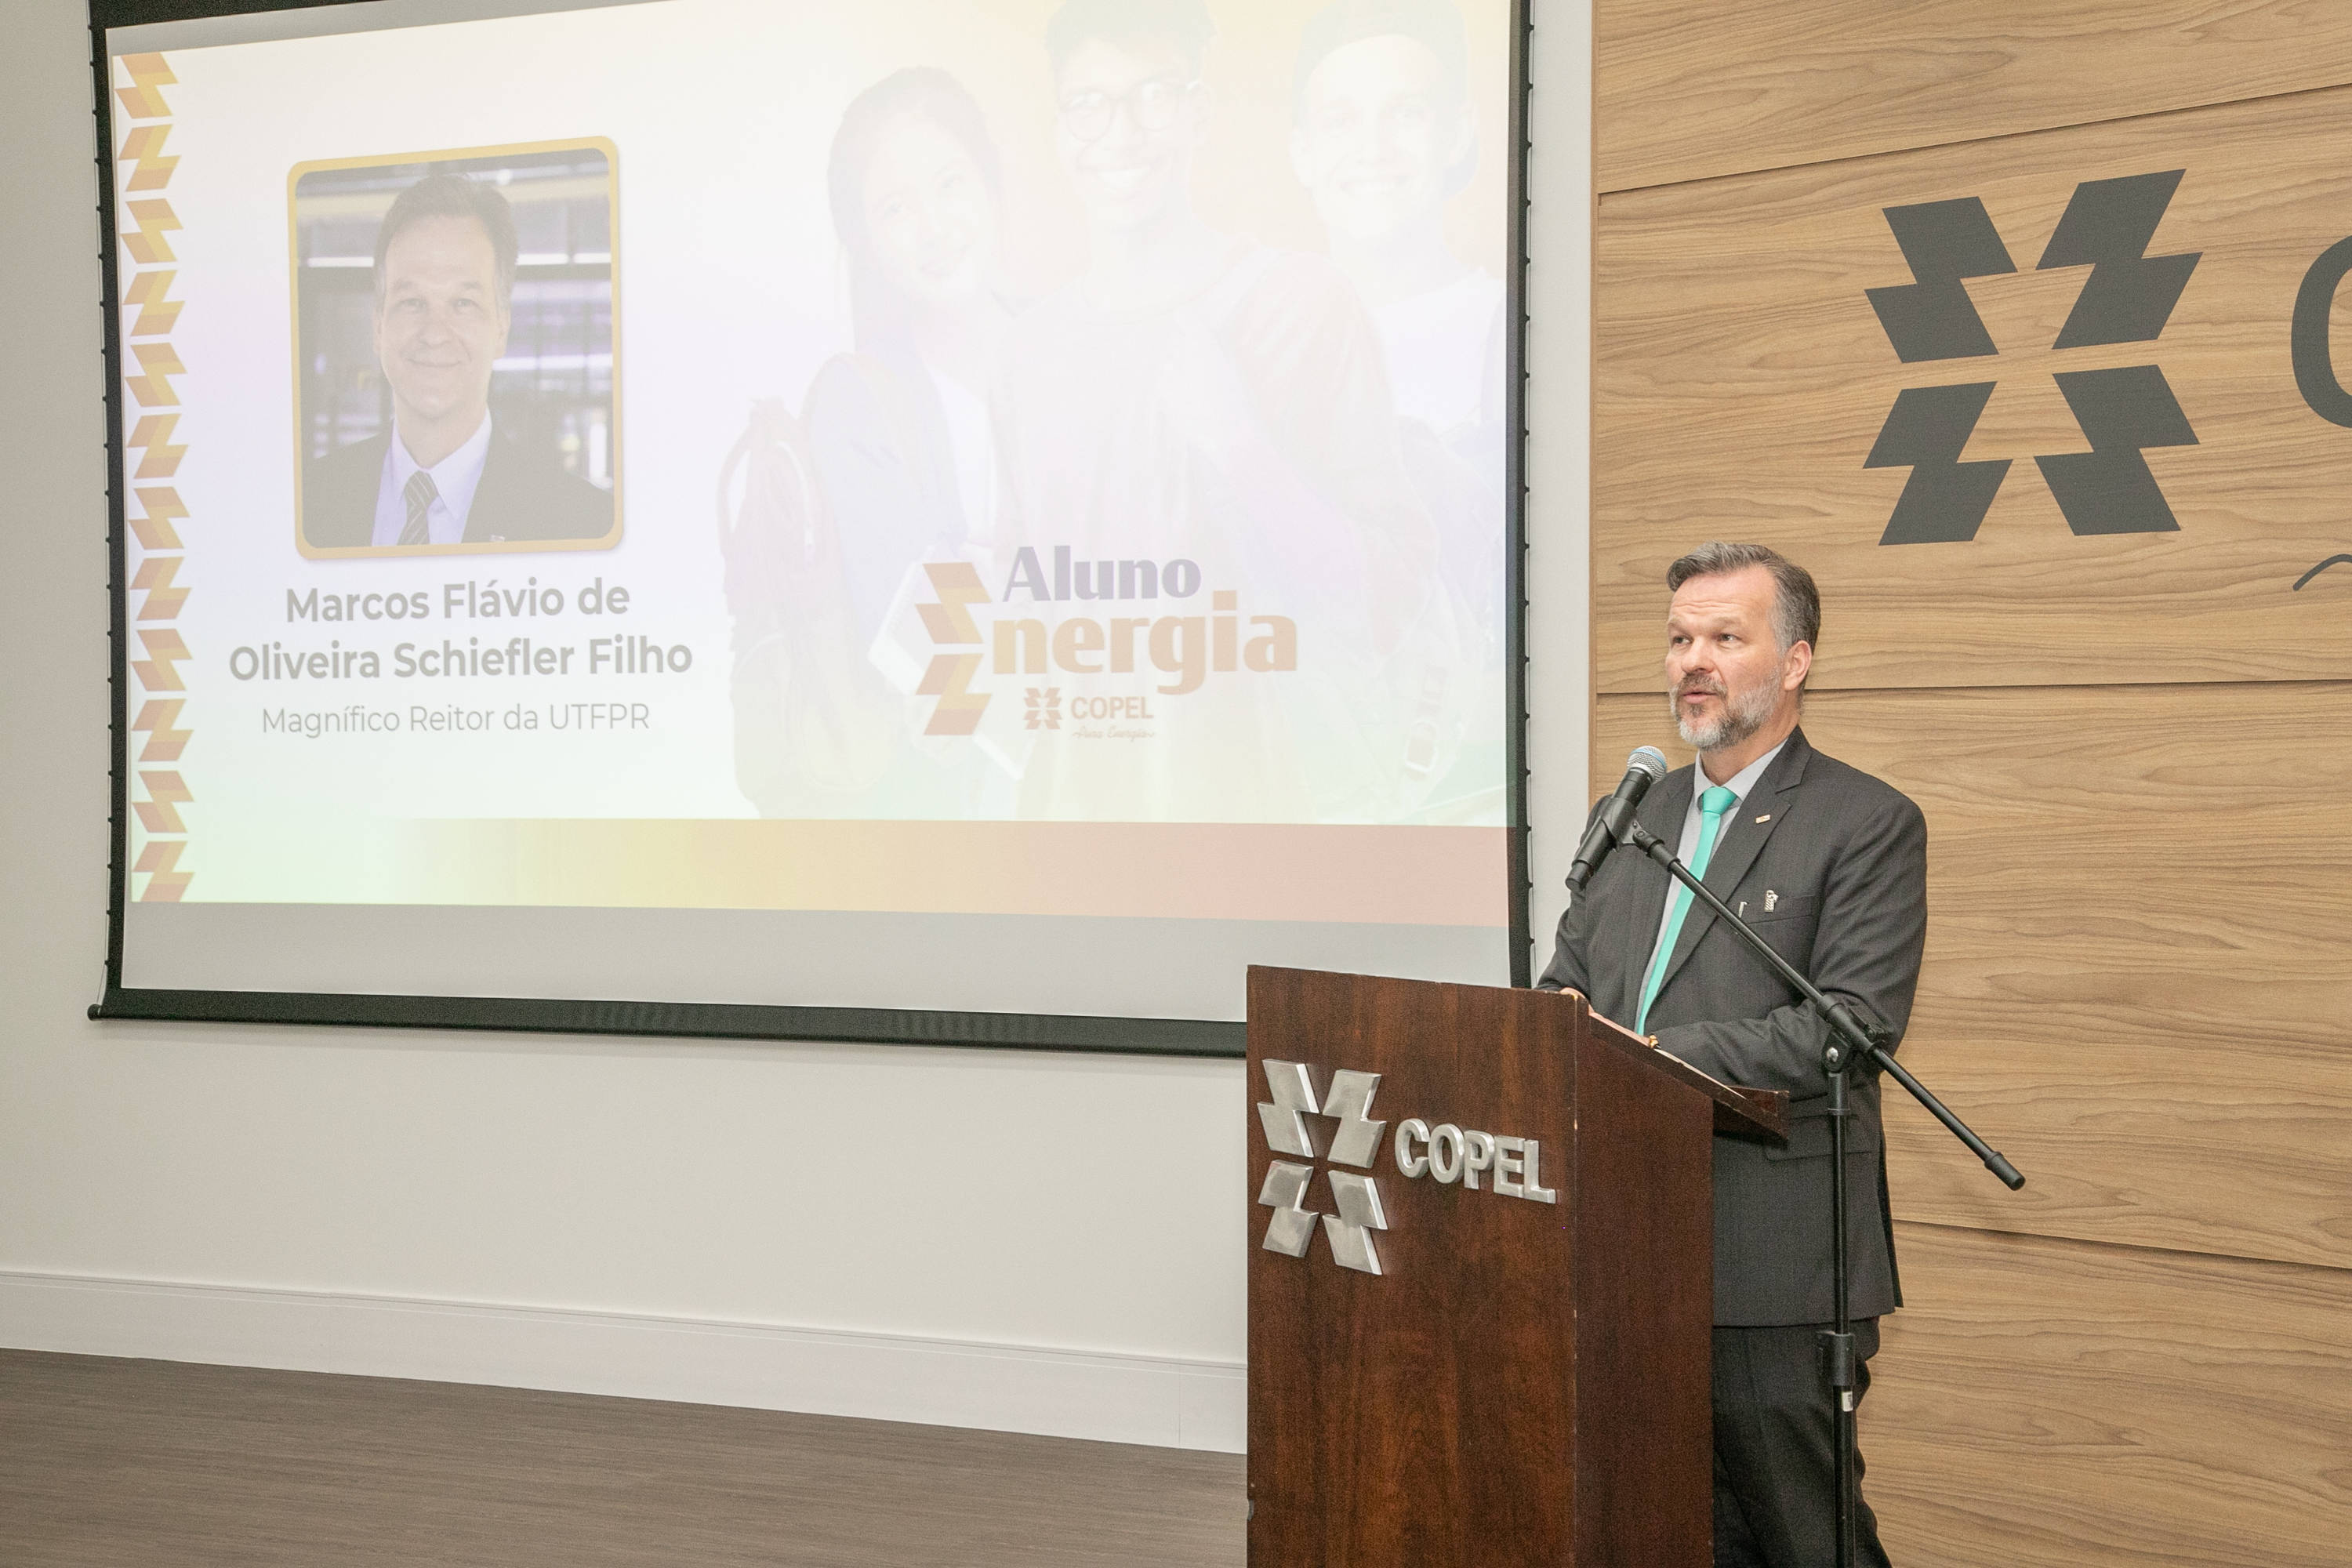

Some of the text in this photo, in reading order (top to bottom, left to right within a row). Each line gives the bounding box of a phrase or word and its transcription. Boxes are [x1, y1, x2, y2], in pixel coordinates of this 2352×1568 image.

[1002, 545, 1201, 602] Aluno
[286, 577, 630, 622] Marcos Flávio de
[229, 633, 693, 681] Oliveira Schiefler Filho
[263, 702, 649, 739] Magnífico Reitor da UTFPR
[1071, 696, 1154, 720] COPEL
[1395, 1118, 1556, 1204] COPEL
